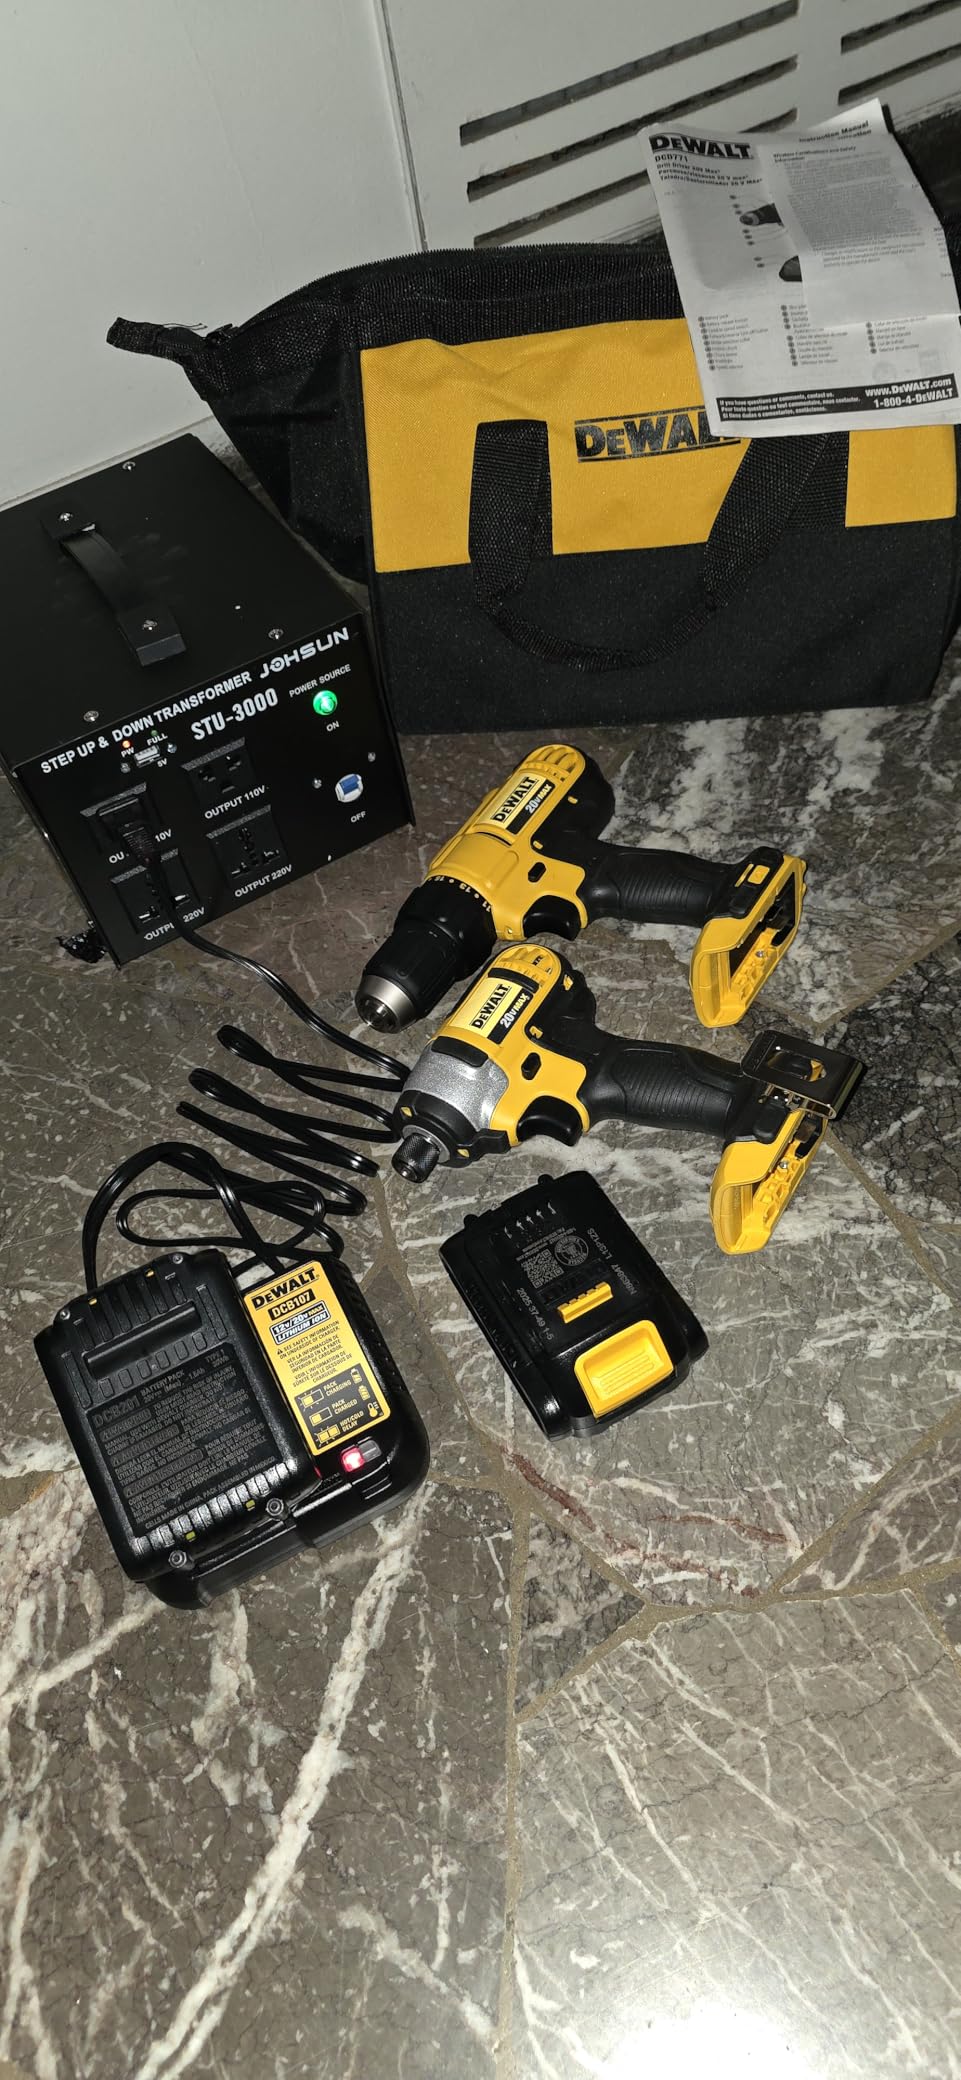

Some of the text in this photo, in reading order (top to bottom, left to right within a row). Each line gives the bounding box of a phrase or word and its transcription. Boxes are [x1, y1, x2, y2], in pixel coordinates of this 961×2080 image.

[842, 120, 869, 134] Manual
[873, 388, 953, 408] 1-800-4-DEWALT
[575, 411, 726, 459] DEWAL
[260, 627, 349, 679] JOHSUN
[289, 664, 351, 697] POWER SOURCE
[41, 671, 252, 773] STEP UP & DOWN TRANSFORMER
[190, 688, 278, 740] STU-3000
[326, 721, 340, 732] ON
[147, 733, 168, 746] FULL
[121, 747, 135, 758] PW
[204, 785, 266, 819] OUTPUT 110V
[350, 811, 367, 823] OFF
[155, 829, 172, 843] 10V
[234, 864, 292, 898] OUTPUT 220V
[183, 906, 205, 923] 220V
[270, 1291, 312, 1318] DCB107
[276, 1311, 327, 1341] LITHIUM ION
[283, 1319, 340, 1351] SEE SAFETY INFORMATION
[139, 1369, 185, 1396] BATTERY PACK
[322, 1380, 337, 1391] PACK
[324, 1379, 352, 1396] CHARGING
[330, 1398, 345, 1409] PACK
[333, 1398, 358, 1414] CHARGED
[341, 1419, 359, 1431] DELAY
